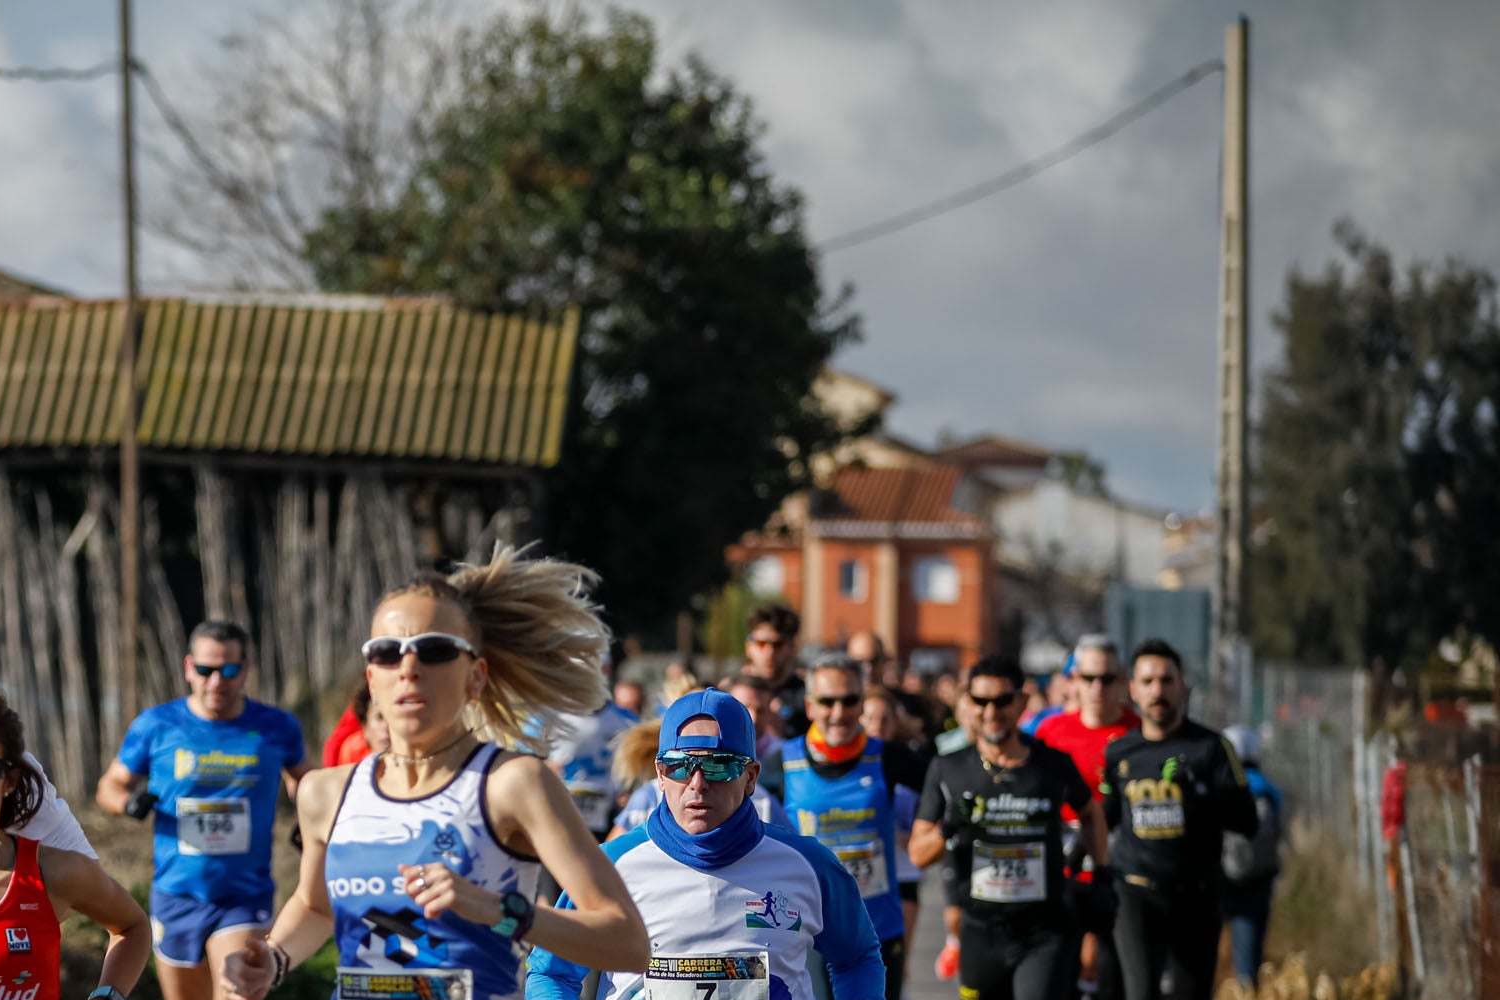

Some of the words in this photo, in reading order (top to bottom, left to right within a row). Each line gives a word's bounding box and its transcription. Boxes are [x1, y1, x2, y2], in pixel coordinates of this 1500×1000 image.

[987, 793, 1051, 814] olimpo
[327, 876, 386, 899] TODO
[8, 929, 14, 942] I
[649, 959, 660, 968] 26
